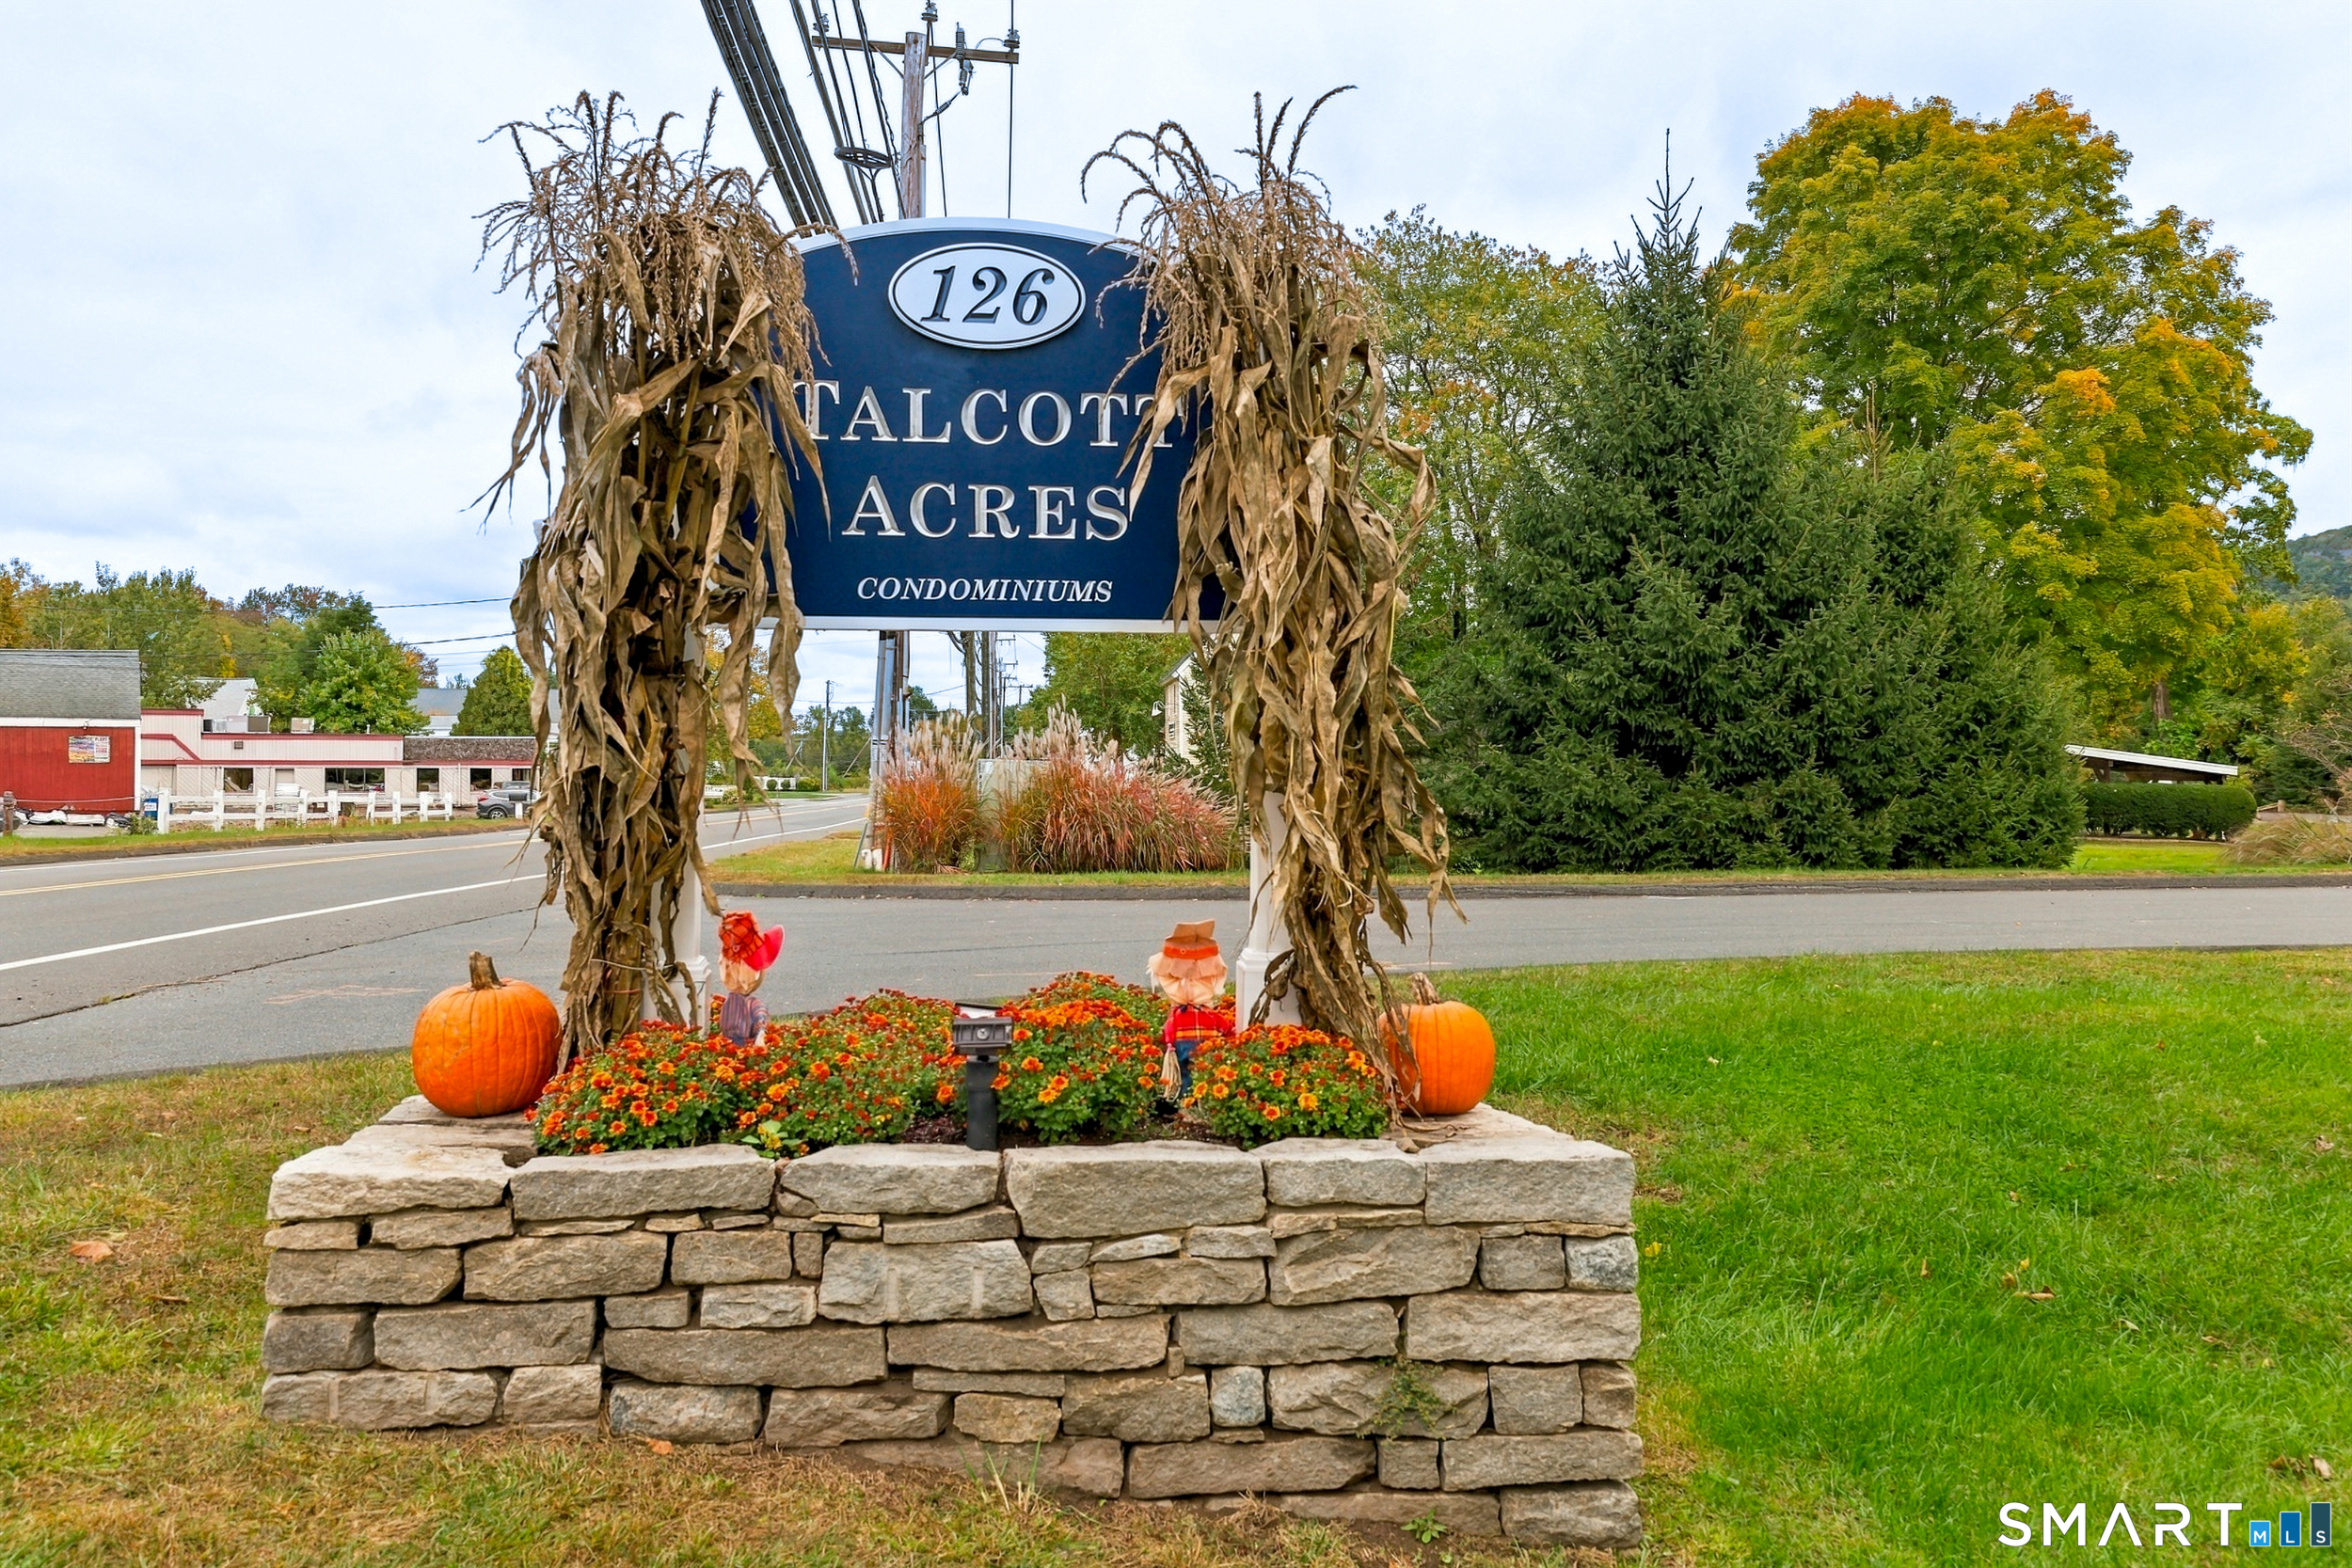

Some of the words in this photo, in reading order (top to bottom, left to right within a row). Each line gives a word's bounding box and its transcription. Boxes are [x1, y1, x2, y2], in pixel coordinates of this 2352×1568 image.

[920, 265, 1055, 325] 126
[841, 475, 1129, 541] ACRES
[857, 576, 1113, 603] CONDOMINIUMS
